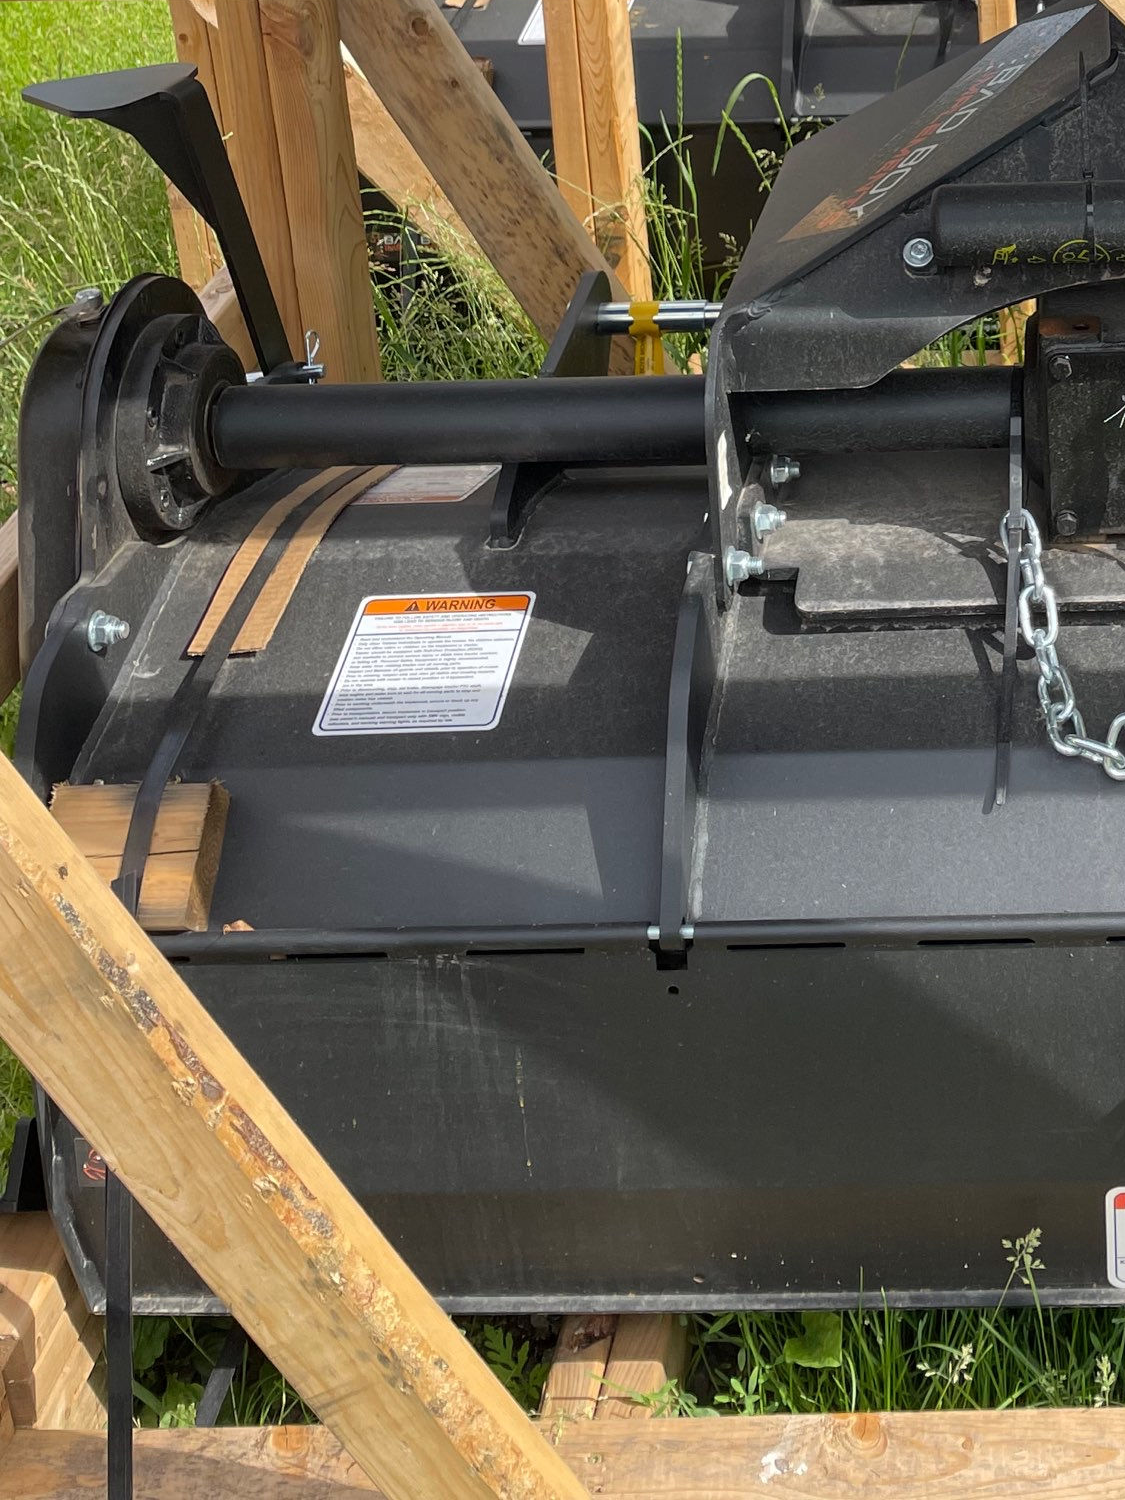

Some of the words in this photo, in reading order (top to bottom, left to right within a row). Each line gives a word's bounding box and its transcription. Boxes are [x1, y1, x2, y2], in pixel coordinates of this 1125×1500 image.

[935, 63, 1025, 134] BAD
[848, 143, 939, 218] BOY
[426, 598, 496, 611] WARNING
